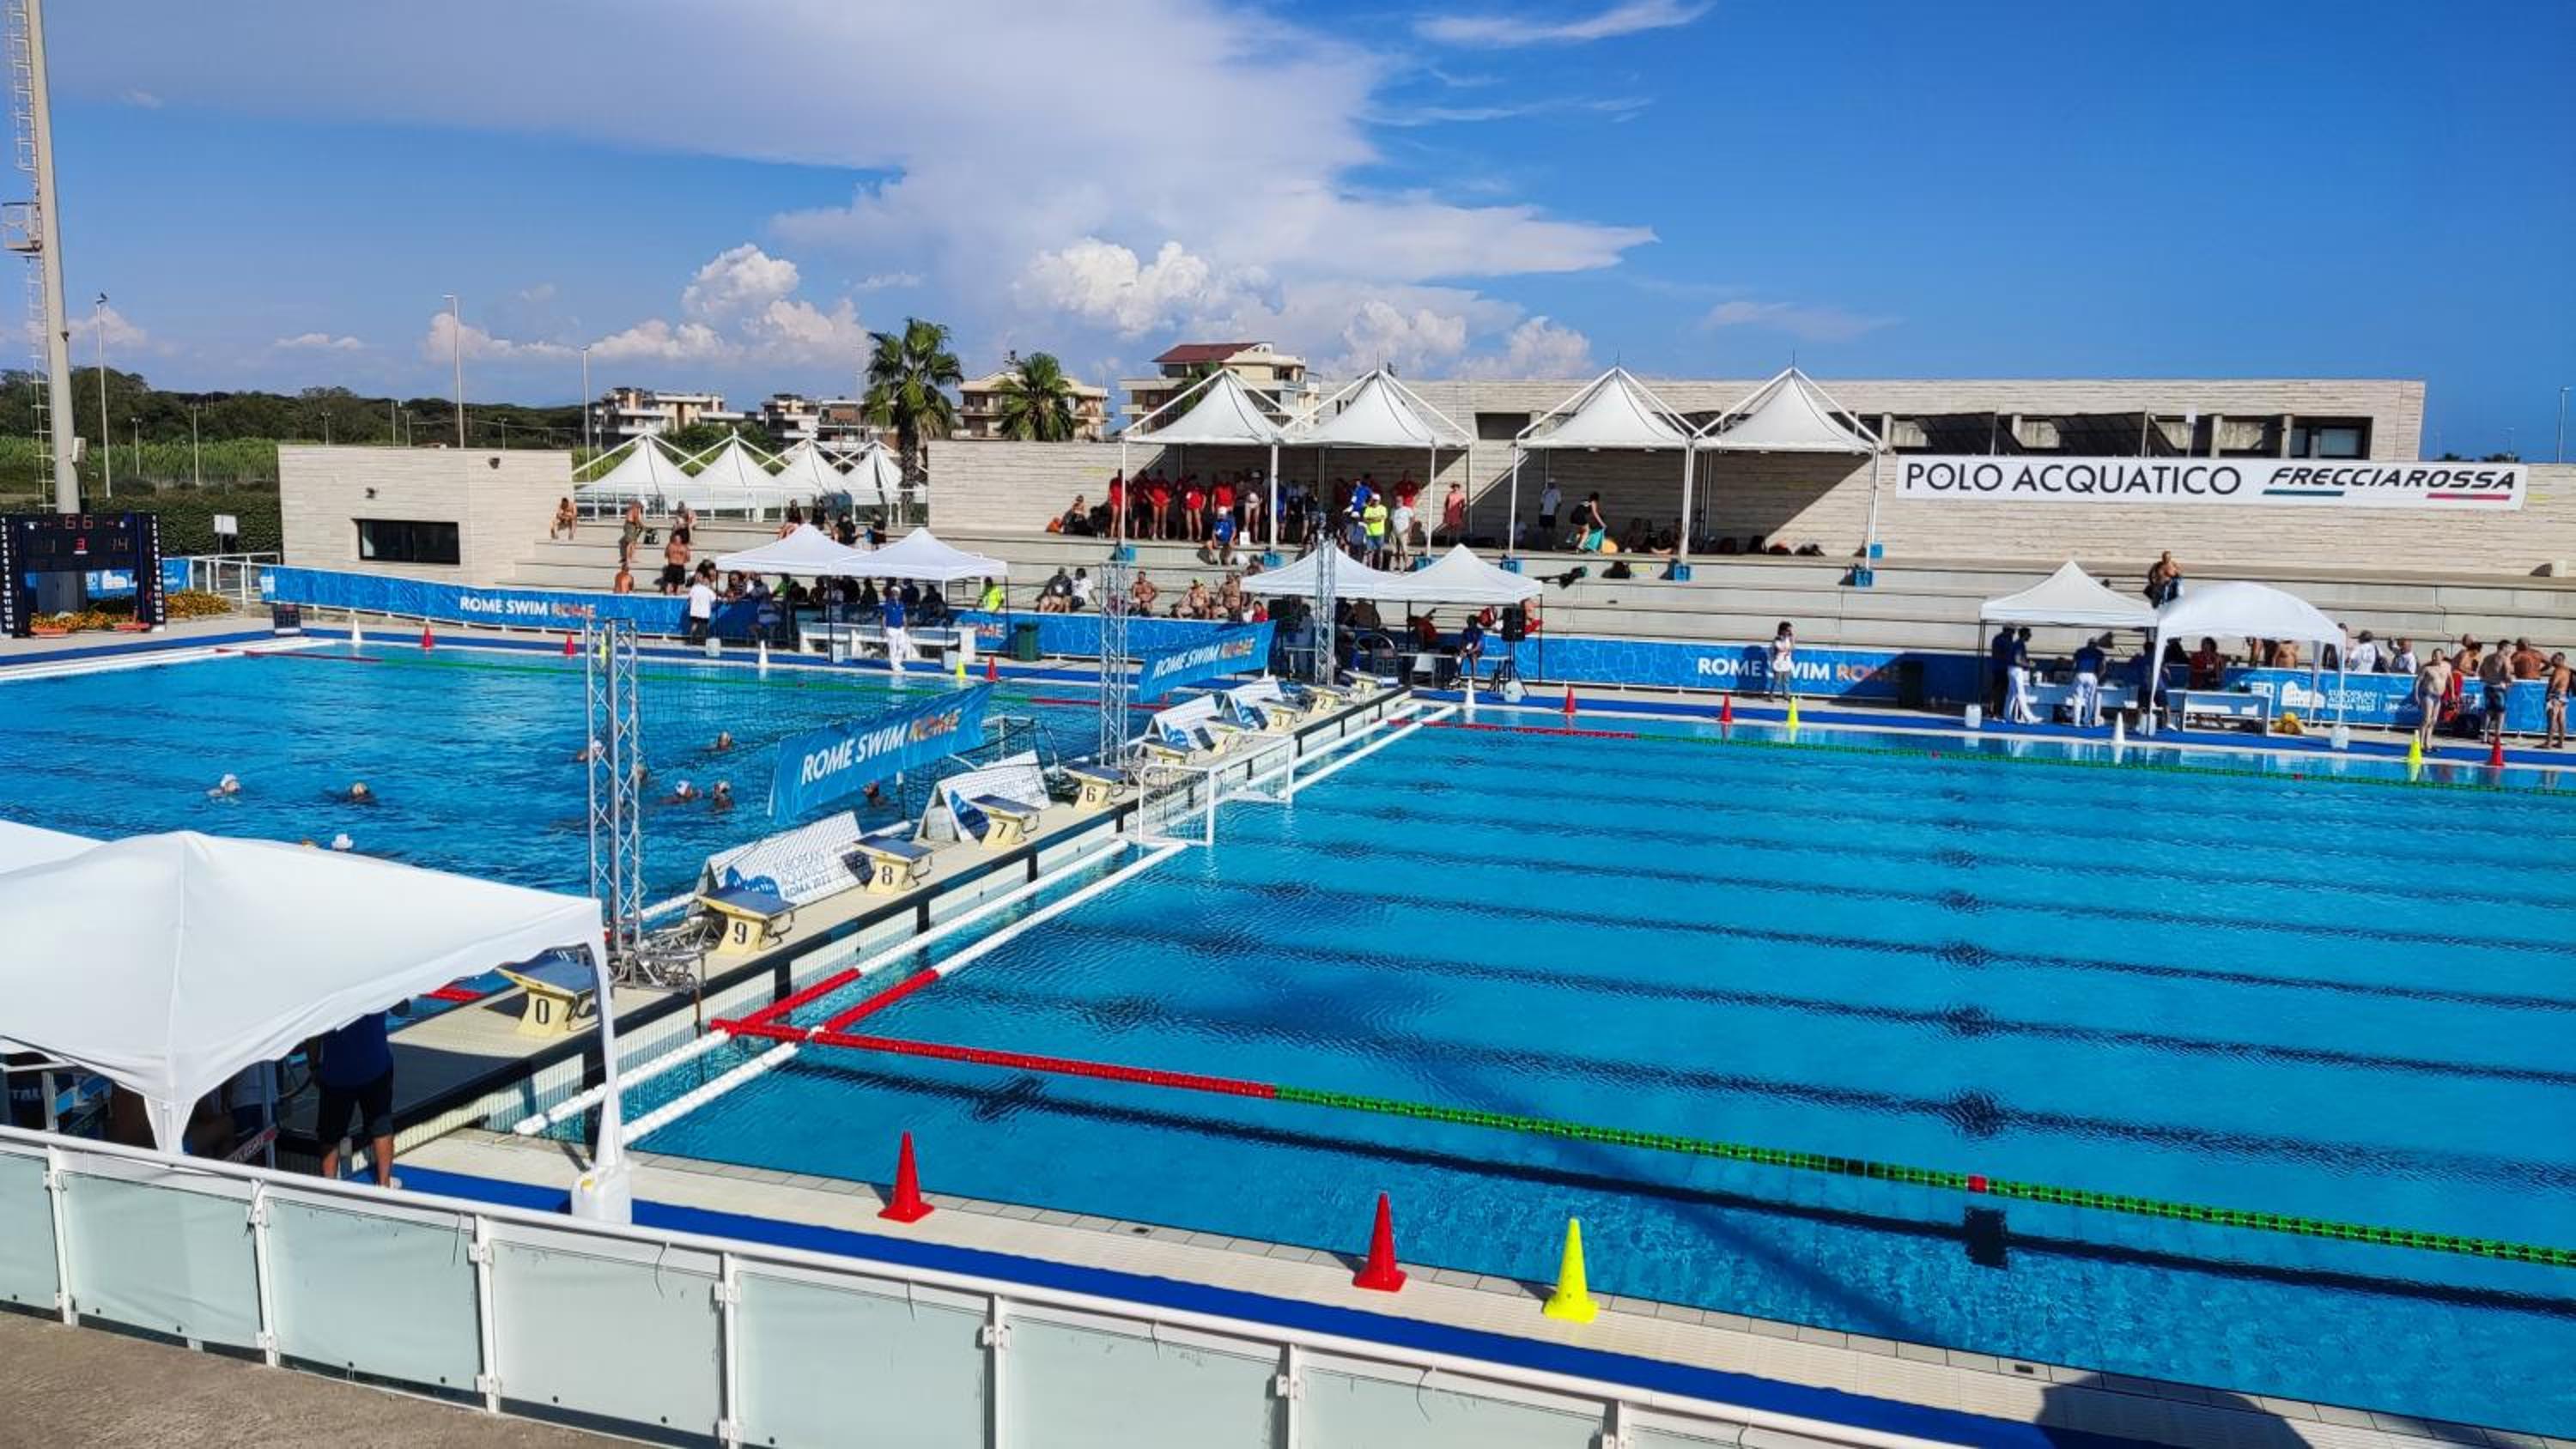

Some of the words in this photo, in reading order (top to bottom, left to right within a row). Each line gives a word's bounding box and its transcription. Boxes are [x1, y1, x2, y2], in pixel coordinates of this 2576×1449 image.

[1906, 463, 2003, 491] POLO
[2012, 464, 2241, 495] ACQUATICO
[2269, 467, 2516, 489] FRECCIAROSSA
[459, 596, 502, 614] ROME
[506, 600, 548, 616] SWIM
[551, 603, 597, 619] ROME
[1152, 652, 1188, 680] ROME
[1186, 643, 1221, 669] SWIM
[1698, 656, 1762, 677] ROME
[1320, 698, 1327, 710] 2
[802, 737, 856, 786] ROME
[855, 722, 908, 763] SWIM
[1086, 785, 1097, 803] 6
[997, 822, 1007, 839] 7
[882, 864, 893, 886] 8
[735, 921, 747, 945] 9
[536, 998, 550, 1025] 0
